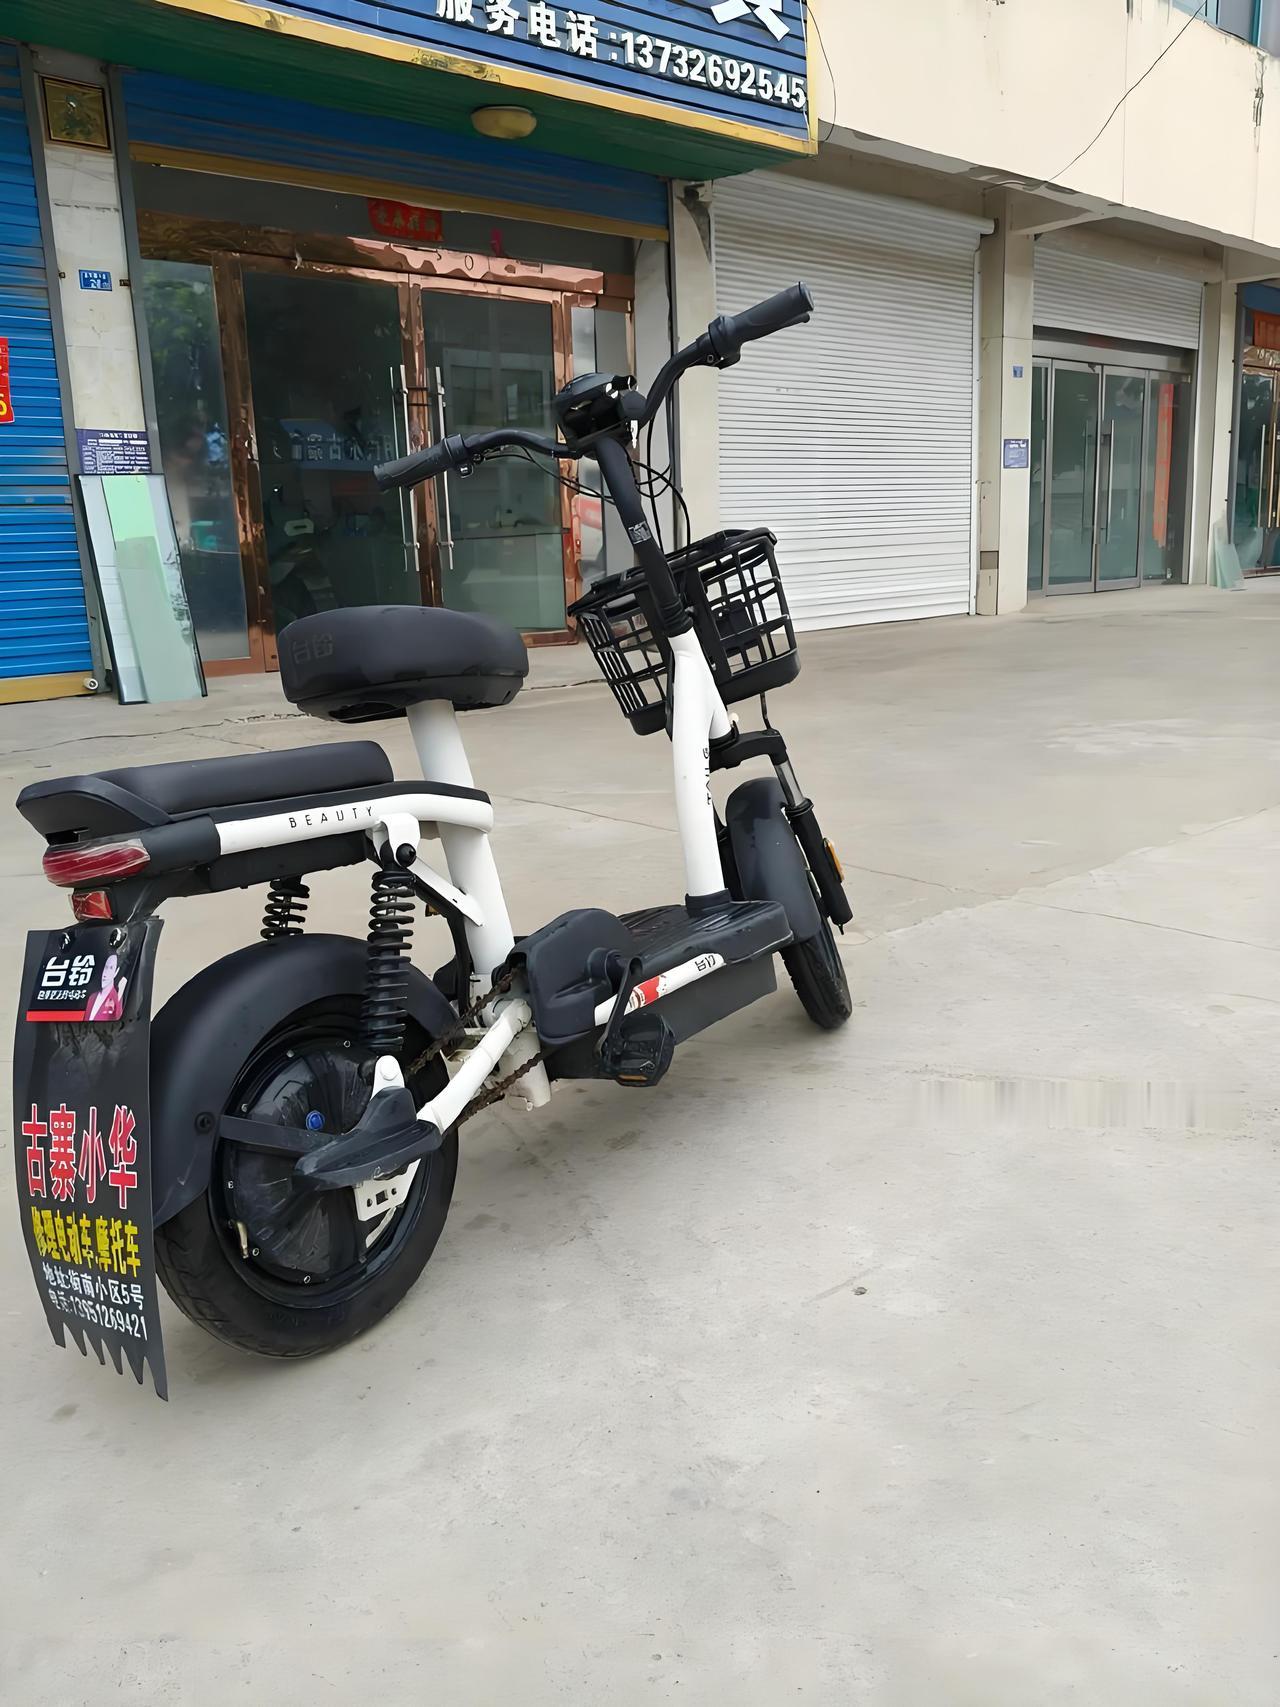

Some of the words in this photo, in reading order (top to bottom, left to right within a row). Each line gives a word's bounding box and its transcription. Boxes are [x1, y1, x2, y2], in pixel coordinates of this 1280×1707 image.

[289, 806, 372, 828] BEAUTY
[22, 1103, 138, 1210] 古寨小华
